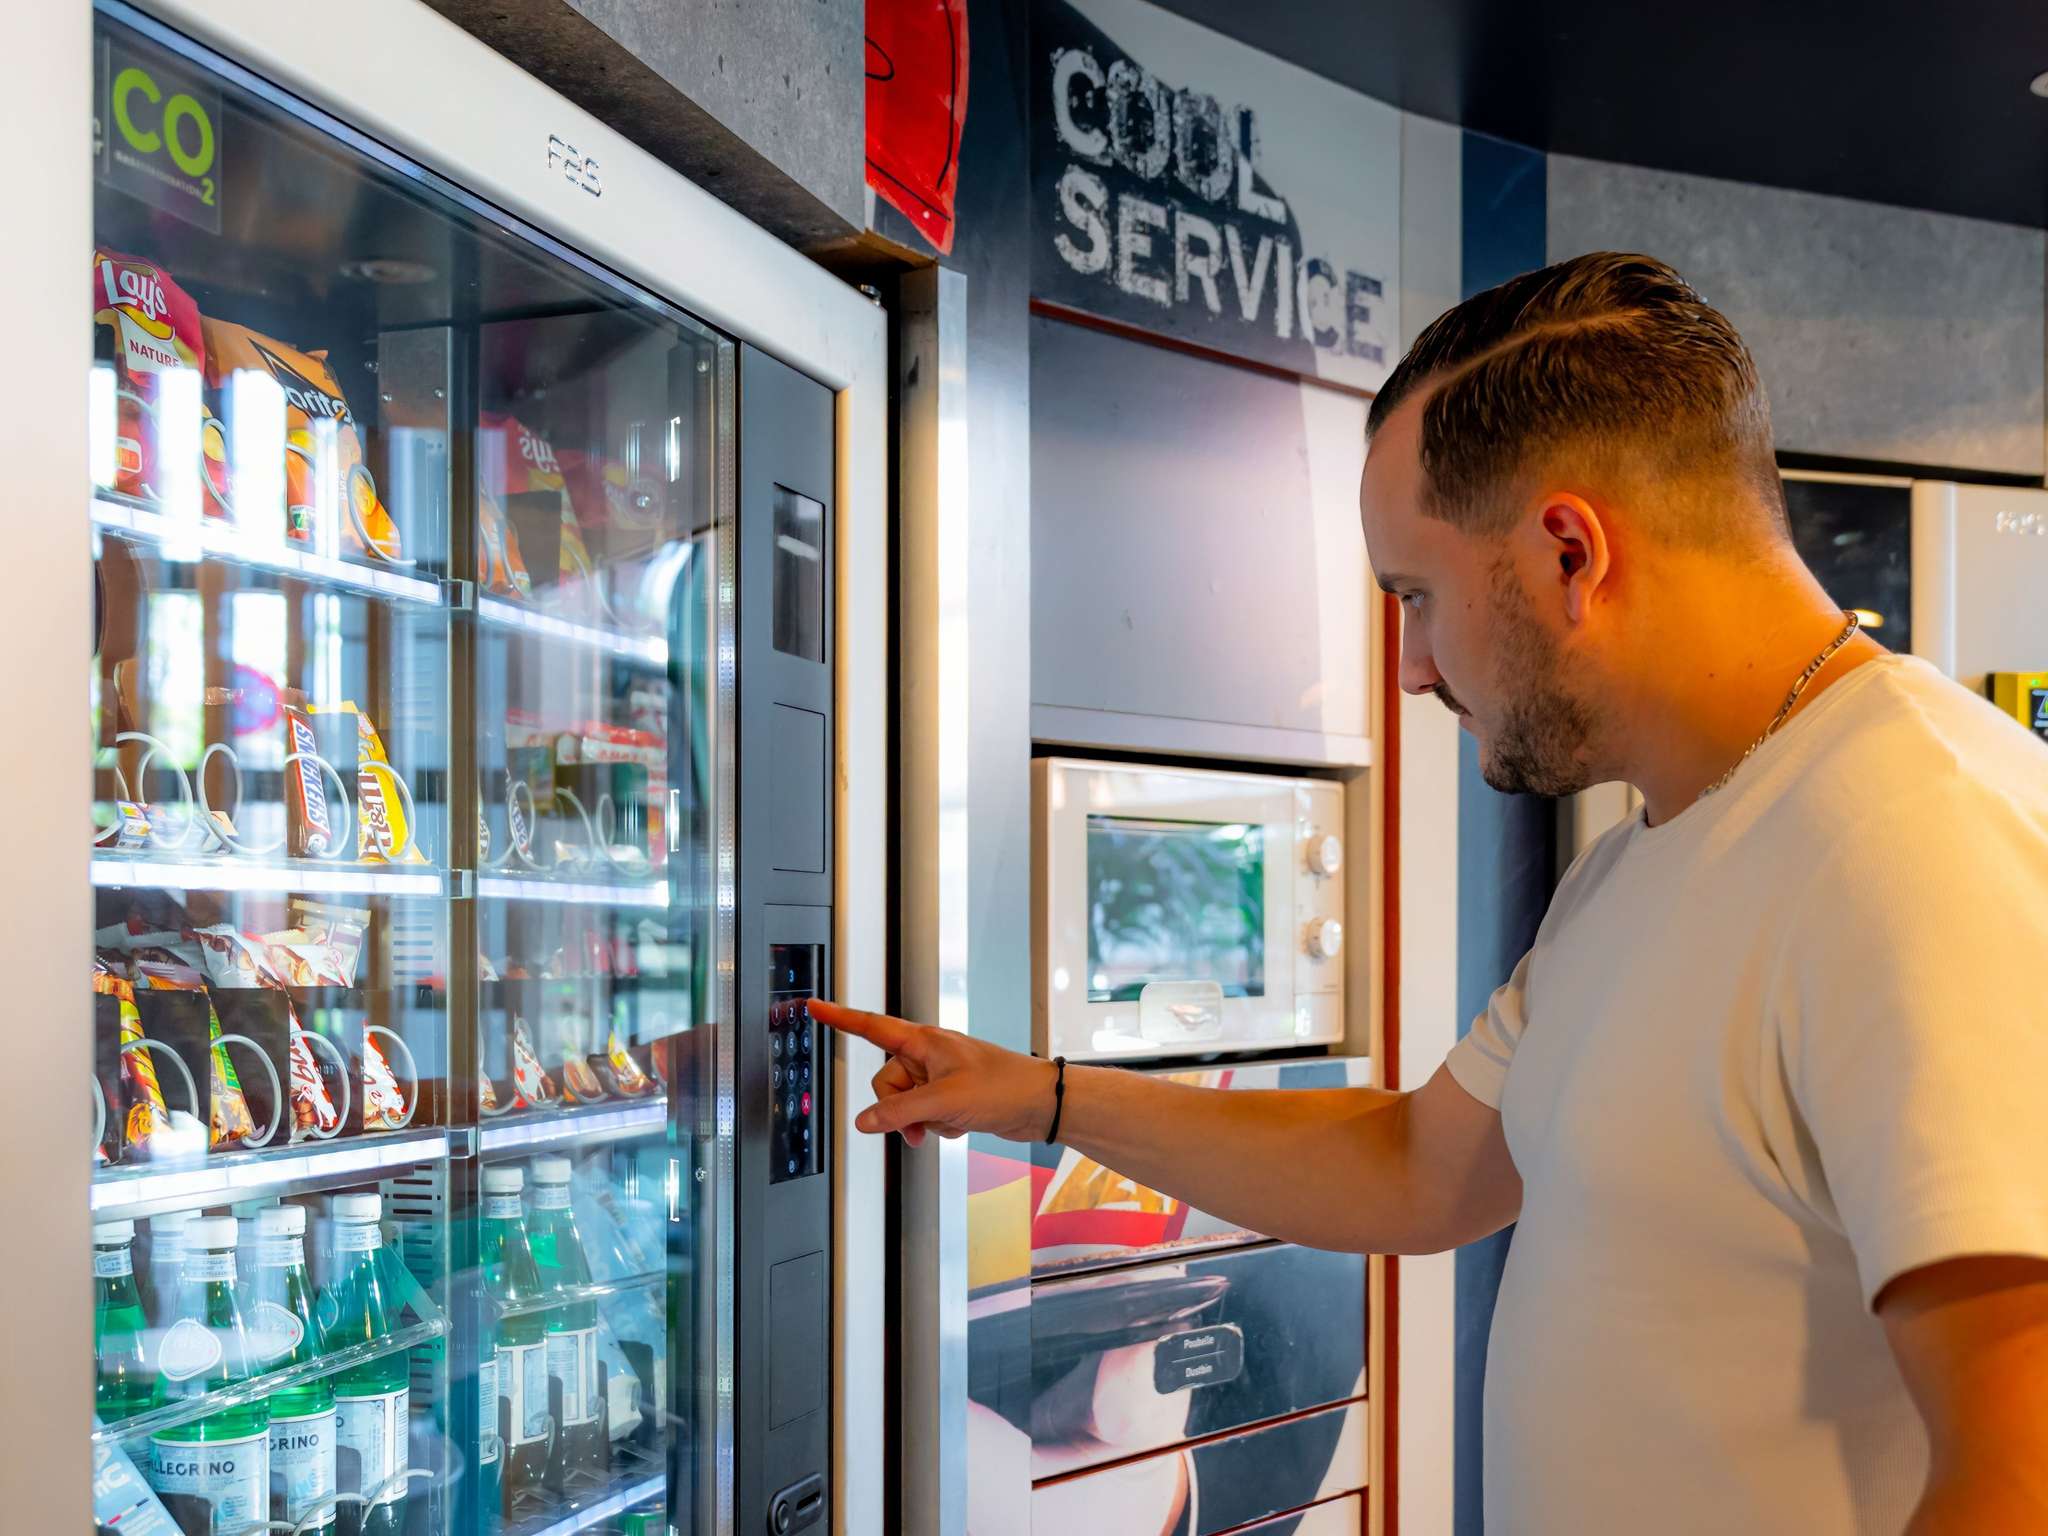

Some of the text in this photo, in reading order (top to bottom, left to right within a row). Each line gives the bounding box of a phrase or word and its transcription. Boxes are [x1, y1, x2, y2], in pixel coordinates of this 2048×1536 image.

[1052, 48, 1286, 225] COOL
[1054, 164, 1385, 365] SERVICE
[296, 723, 329, 830] SNCKERS
[789, 1007, 794, 1018] 2
[774, 1037, 809, 1050] 4 5 6
[774, 1067, 809, 1082] 7 8 9
